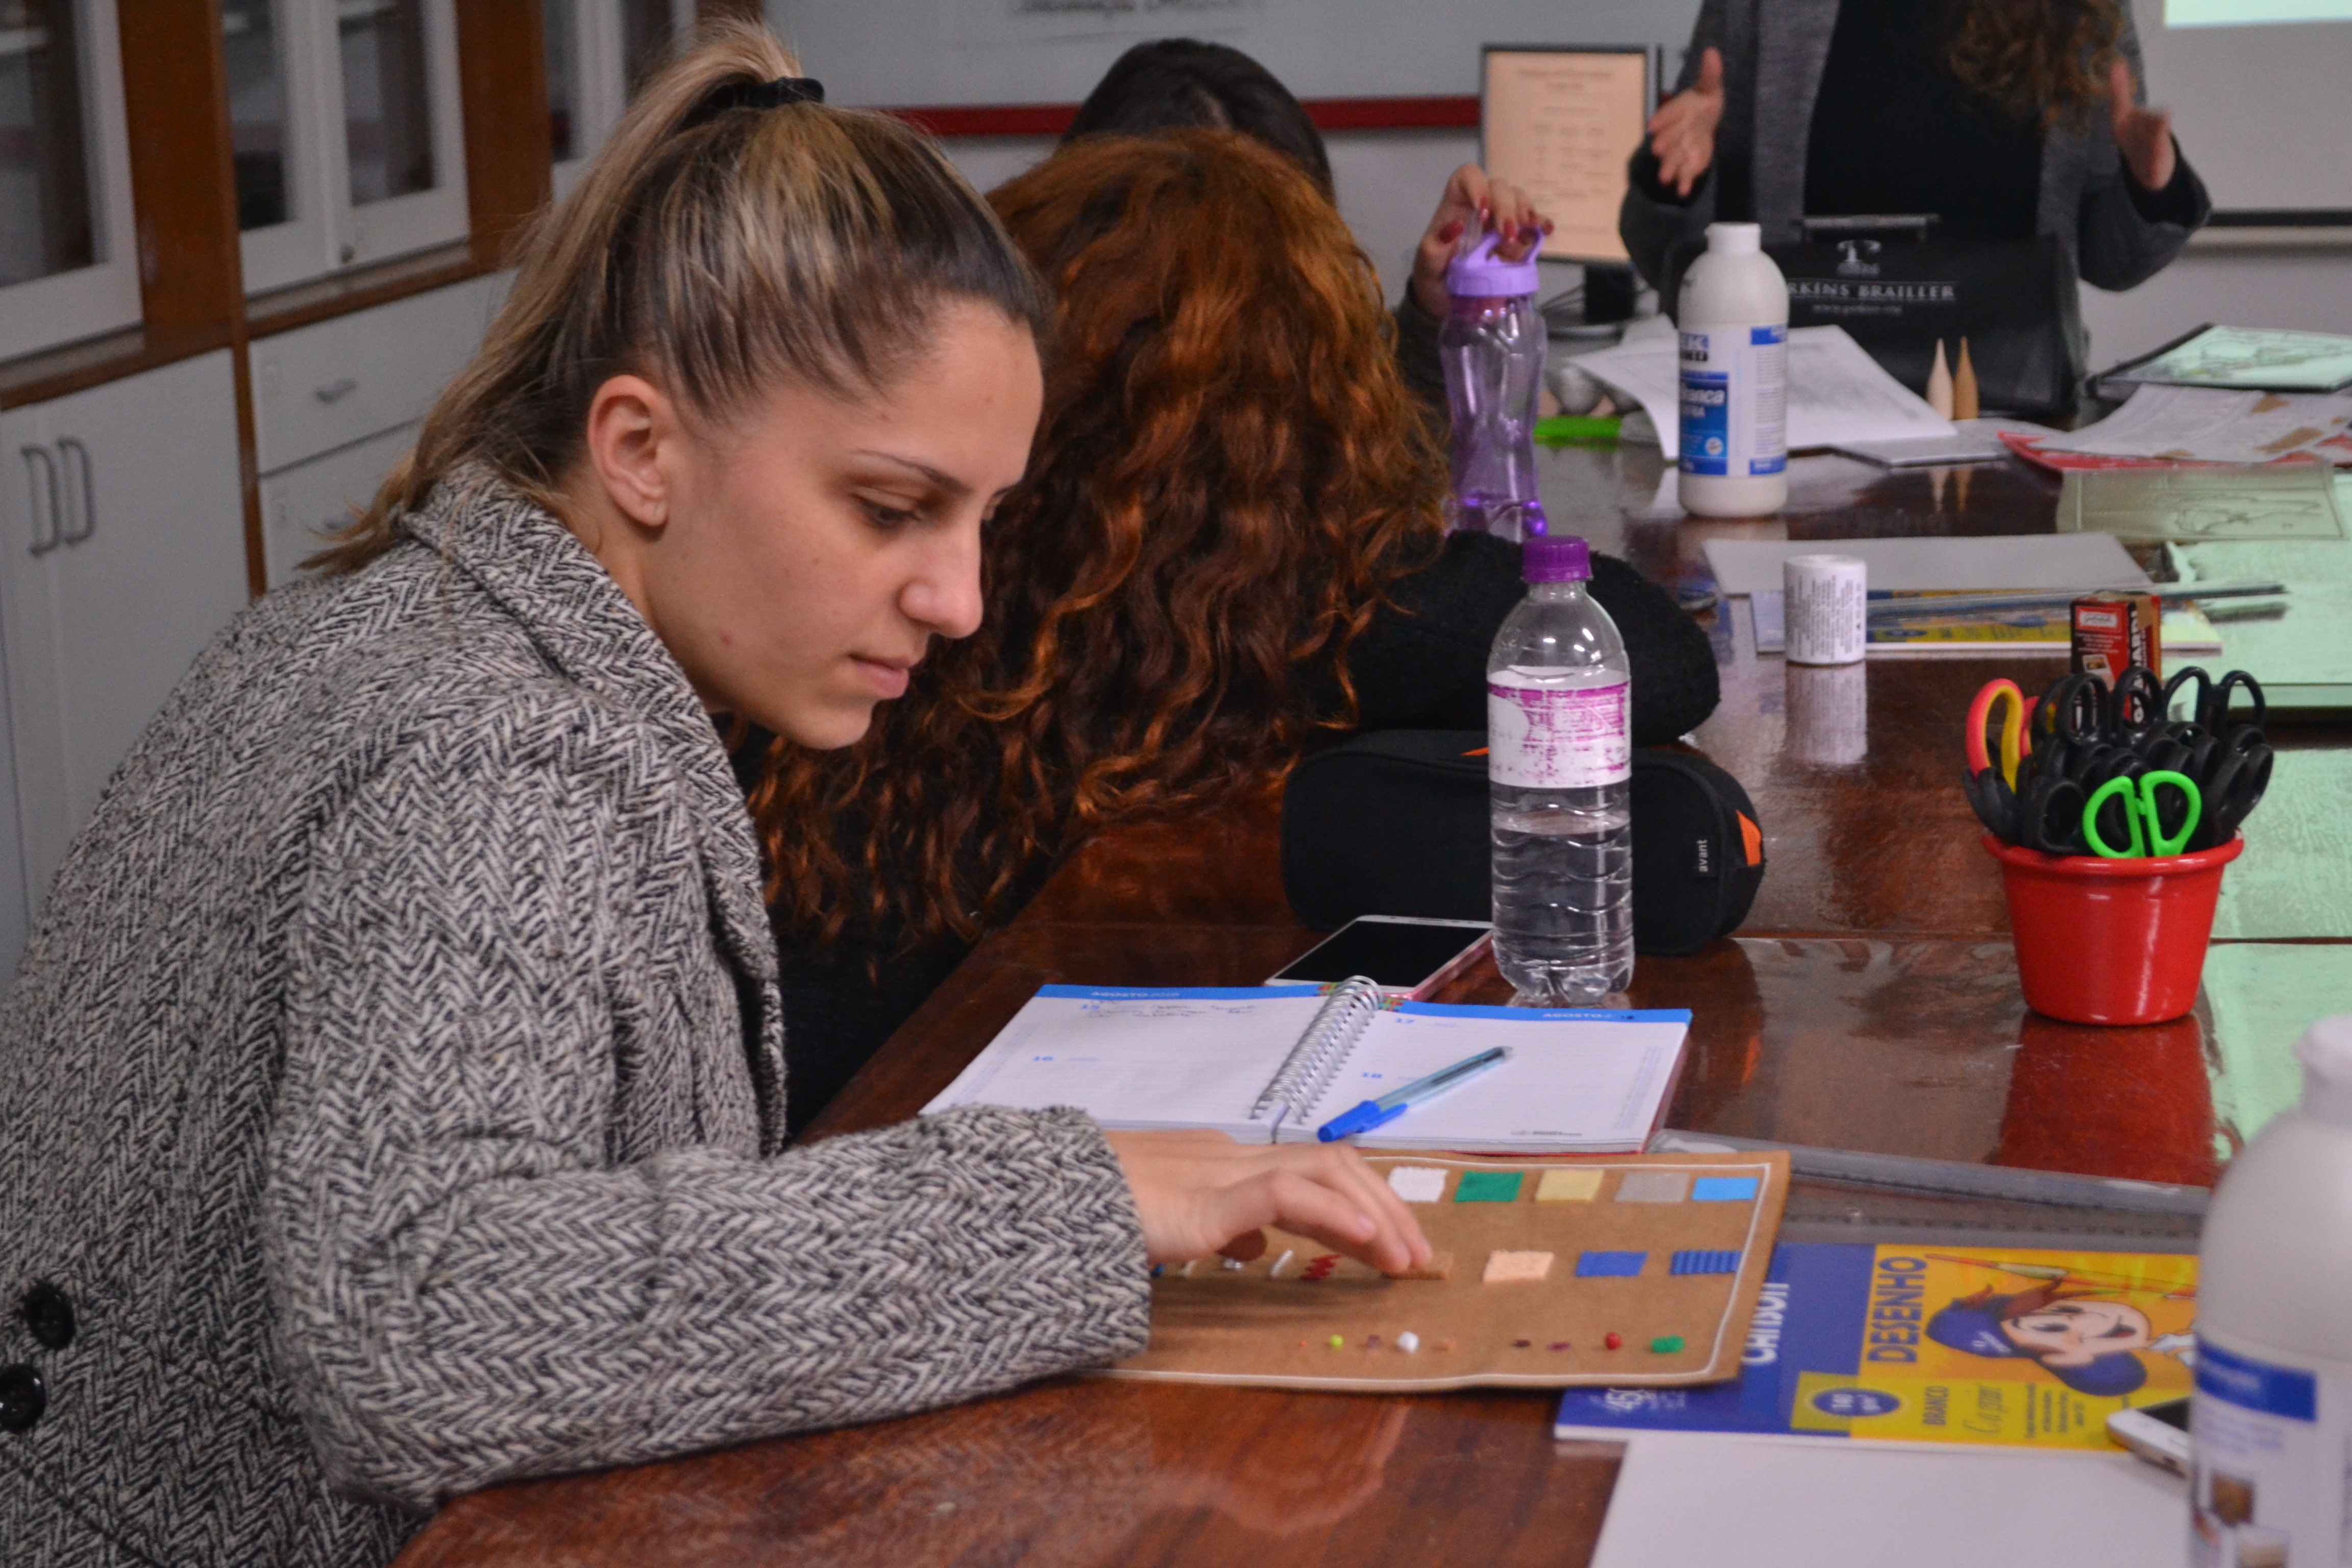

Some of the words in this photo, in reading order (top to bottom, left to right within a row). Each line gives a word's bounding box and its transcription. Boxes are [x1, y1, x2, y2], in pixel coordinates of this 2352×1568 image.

[1787, 282, 1850, 297] RKINS
[1858, 284, 1954, 300] BRAILLER
[1698, 840, 1708, 872] avant
[1868, 1257, 1928, 1363] DESENHO
[1923, 1386, 1950, 1425] BRANCO
